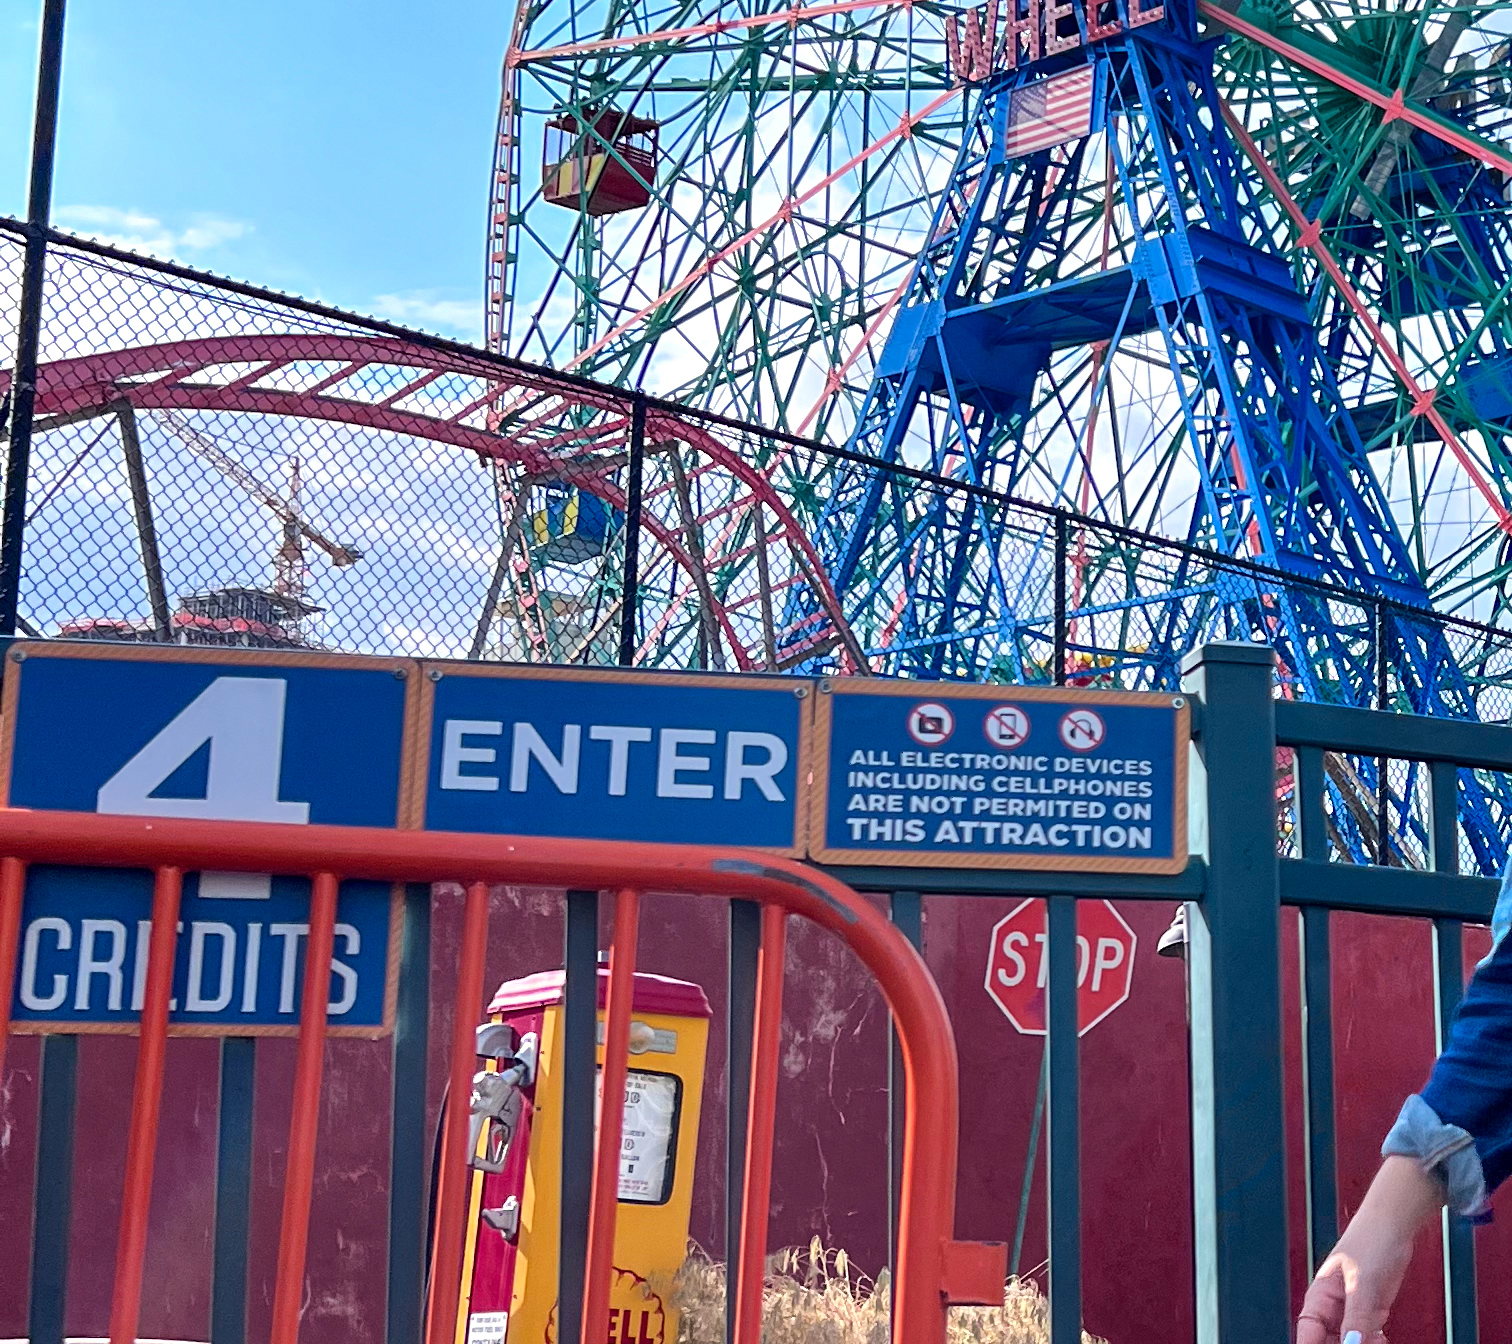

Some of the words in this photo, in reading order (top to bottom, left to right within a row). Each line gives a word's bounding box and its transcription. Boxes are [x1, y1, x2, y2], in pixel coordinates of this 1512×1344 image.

[440, 719, 788, 802] ENTER
[849, 749, 895, 767] ALL
[900, 751, 1049, 772] ELECTRONIC
[1053, 757, 1153, 775] DEVICES
[97, 676, 311, 899] 4
[848, 771, 986, 792] INCLUDING
[991, 776, 1153, 798] CELLPHONES
[847, 793, 904, 813] ARE
[909, 795, 967, 815] NOT
[973, 797, 1106, 819] PERMITED
[1113, 803, 1152, 821] ON
[846, 817, 926, 842] THIS
[933, 820, 1152, 849] ATTRACTION
